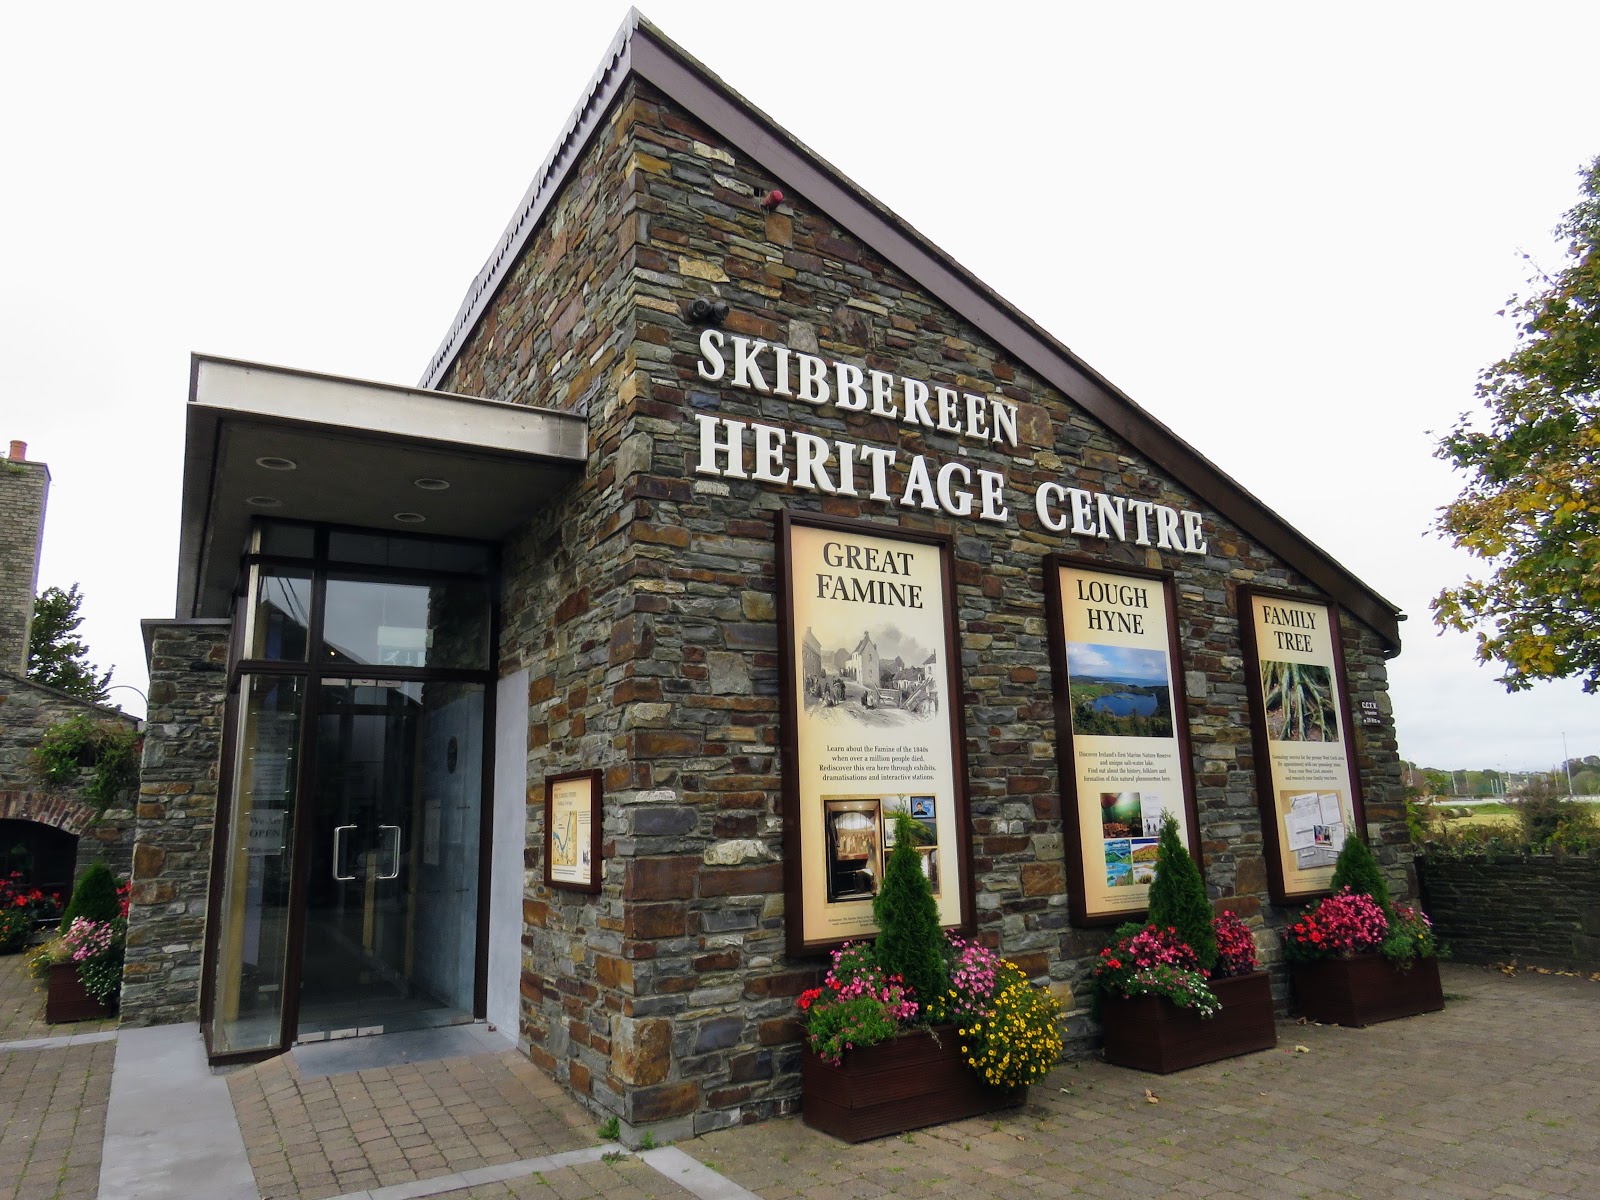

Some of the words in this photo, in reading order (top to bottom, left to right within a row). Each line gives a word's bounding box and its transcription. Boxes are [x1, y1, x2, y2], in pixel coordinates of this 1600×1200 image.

[696, 328, 1020, 449] SKIBBEREEN
[694, 413, 1009, 523] HERITAGE
[1034, 481, 1208, 556] CENTRE
[823, 542, 914, 577] GREAT
[816, 573, 923, 609] FAMINE
[1076, 579, 1148, 609] LOUGH
[1086, 608, 1144, 635] HYNE
[1262, 605, 1317, 630] FAMILY
[1273, 631, 1313, 653] TREE
[249, 829, 280, 838] OPEN
